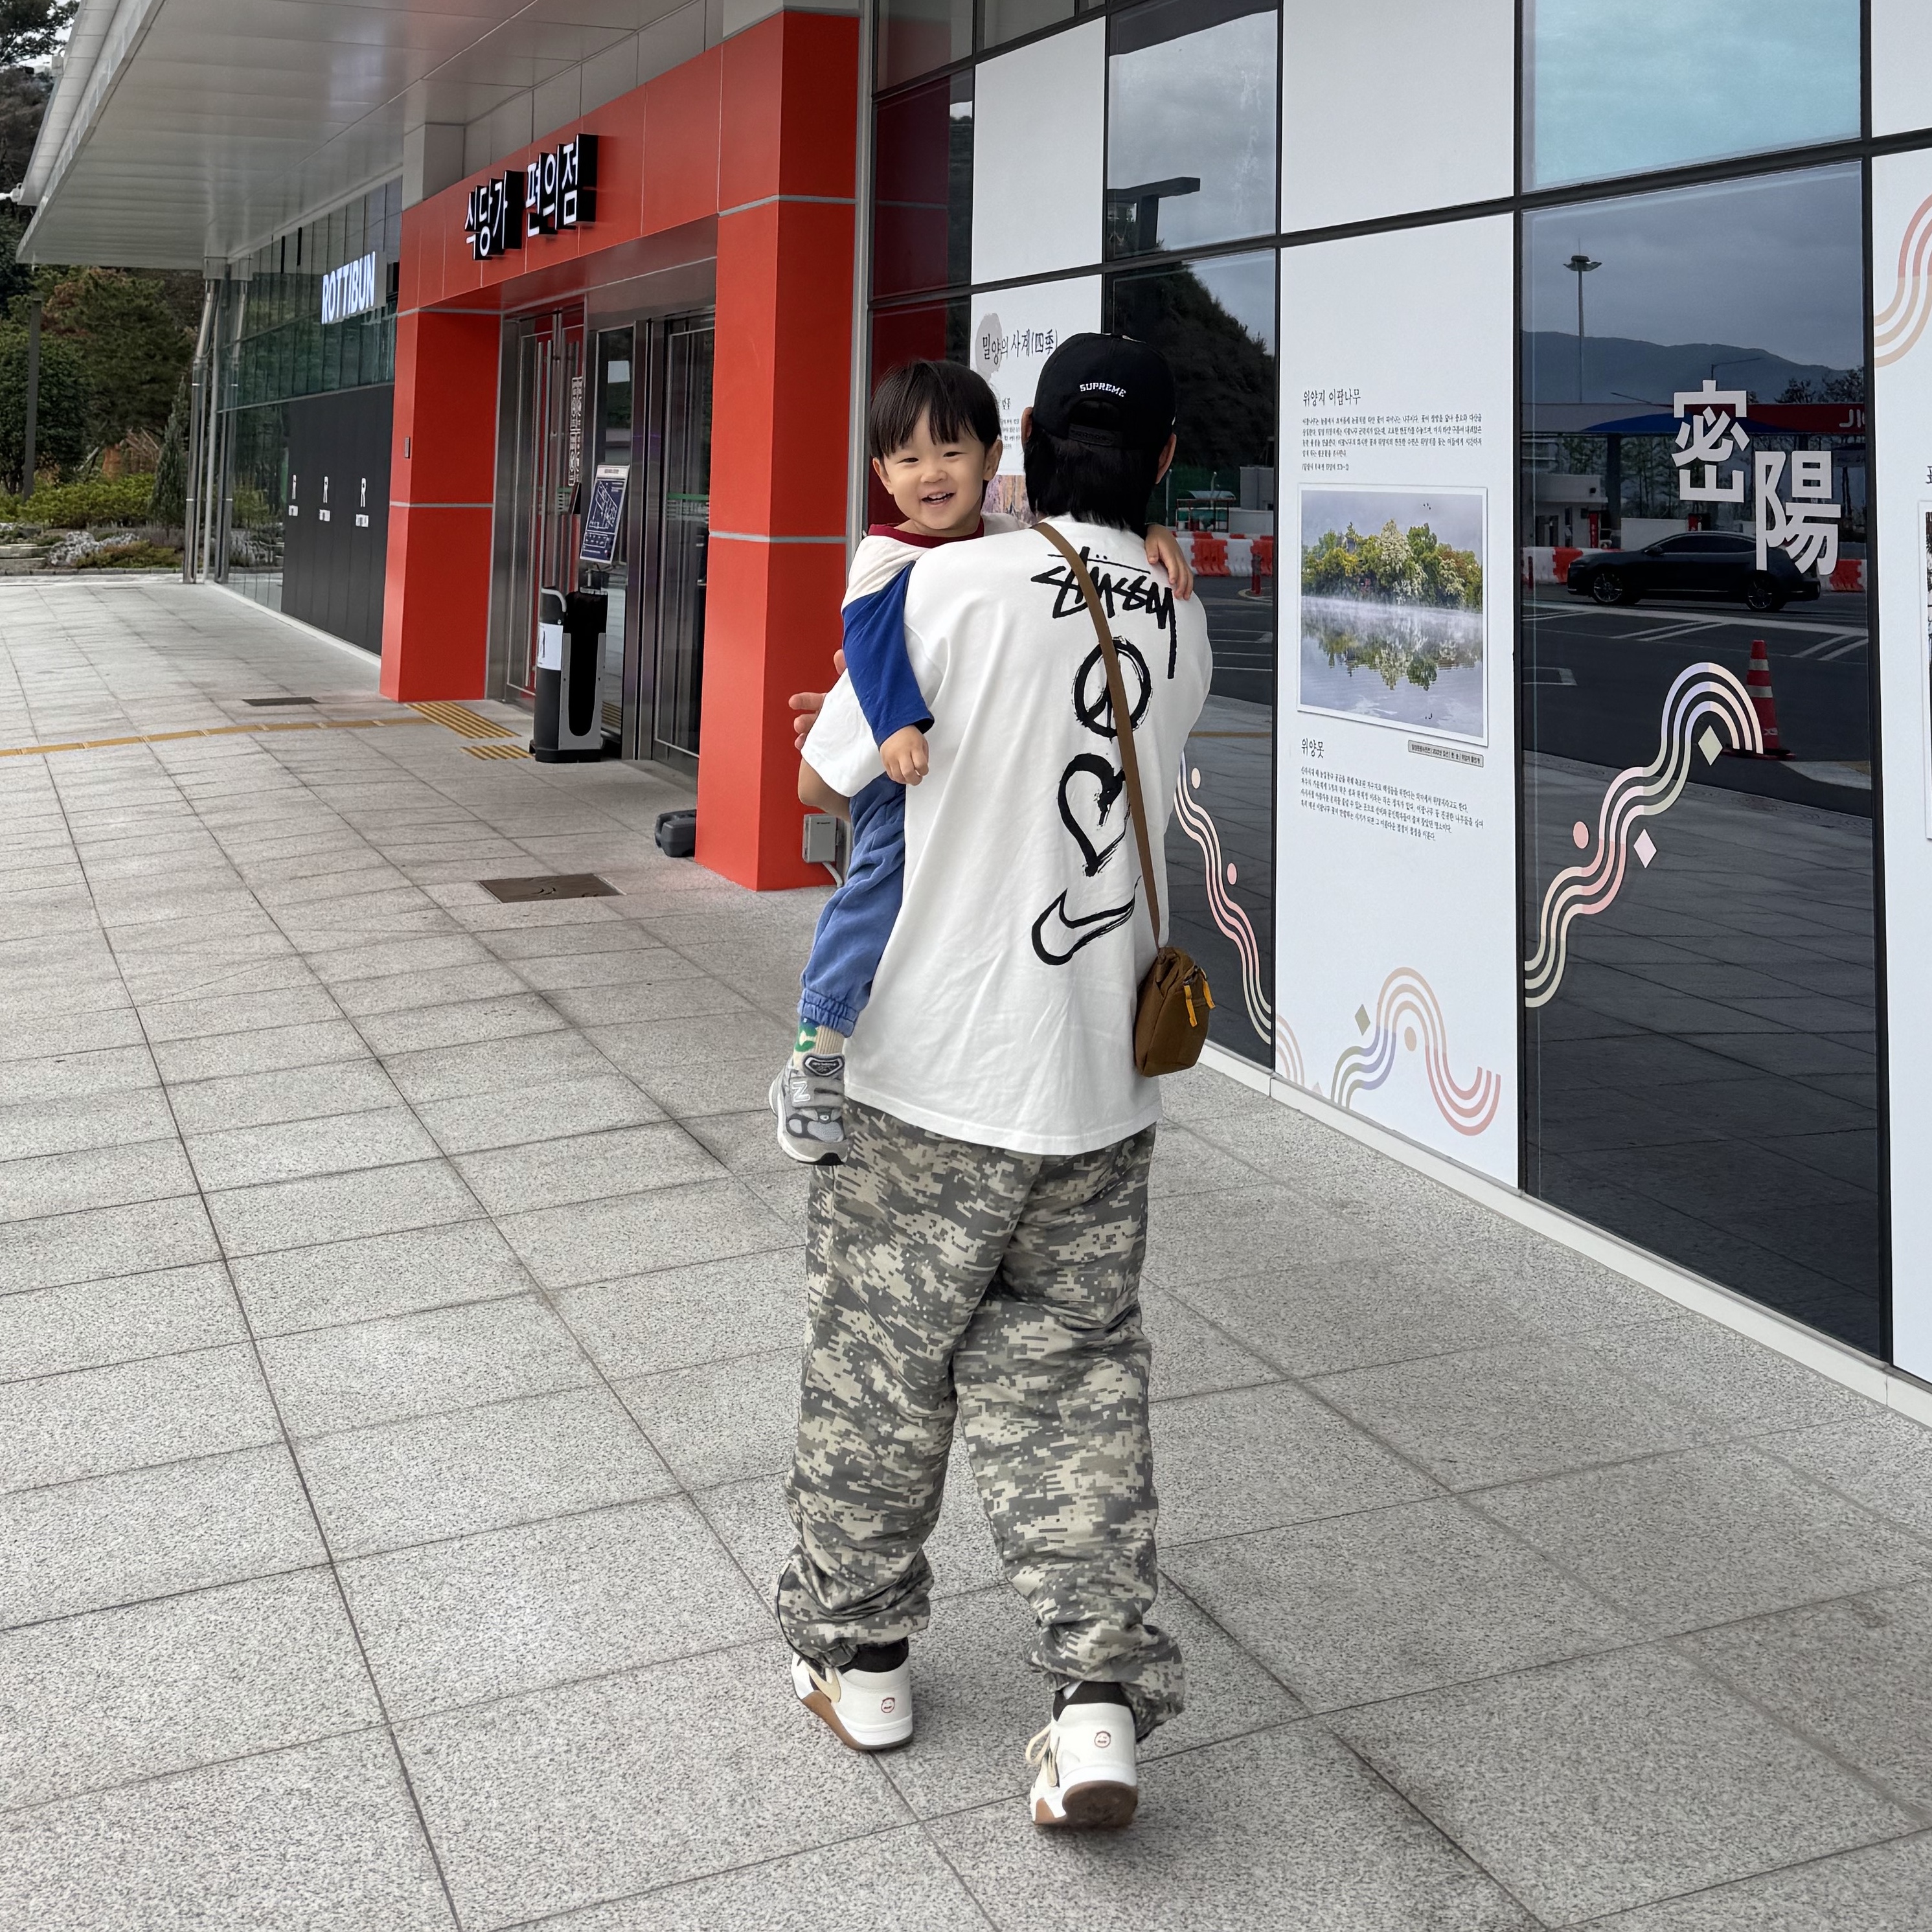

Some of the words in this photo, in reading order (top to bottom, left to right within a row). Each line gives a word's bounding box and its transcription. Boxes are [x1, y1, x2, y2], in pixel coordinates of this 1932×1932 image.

[464, 170, 508, 260] 식당가
[525, 134, 579, 237] 편의점
[321, 251, 376, 324] ROTTIBUN
[983, 333, 1008, 365] 밀양의
[1079, 381, 1127, 398] SUPREME
[1302, 389, 1325, 407] 위양지
[1328, 388, 1361, 407] 이팝나무
[1301, 738, 1324, 759] 위양못
[791, 1080, 812, 1103] N
